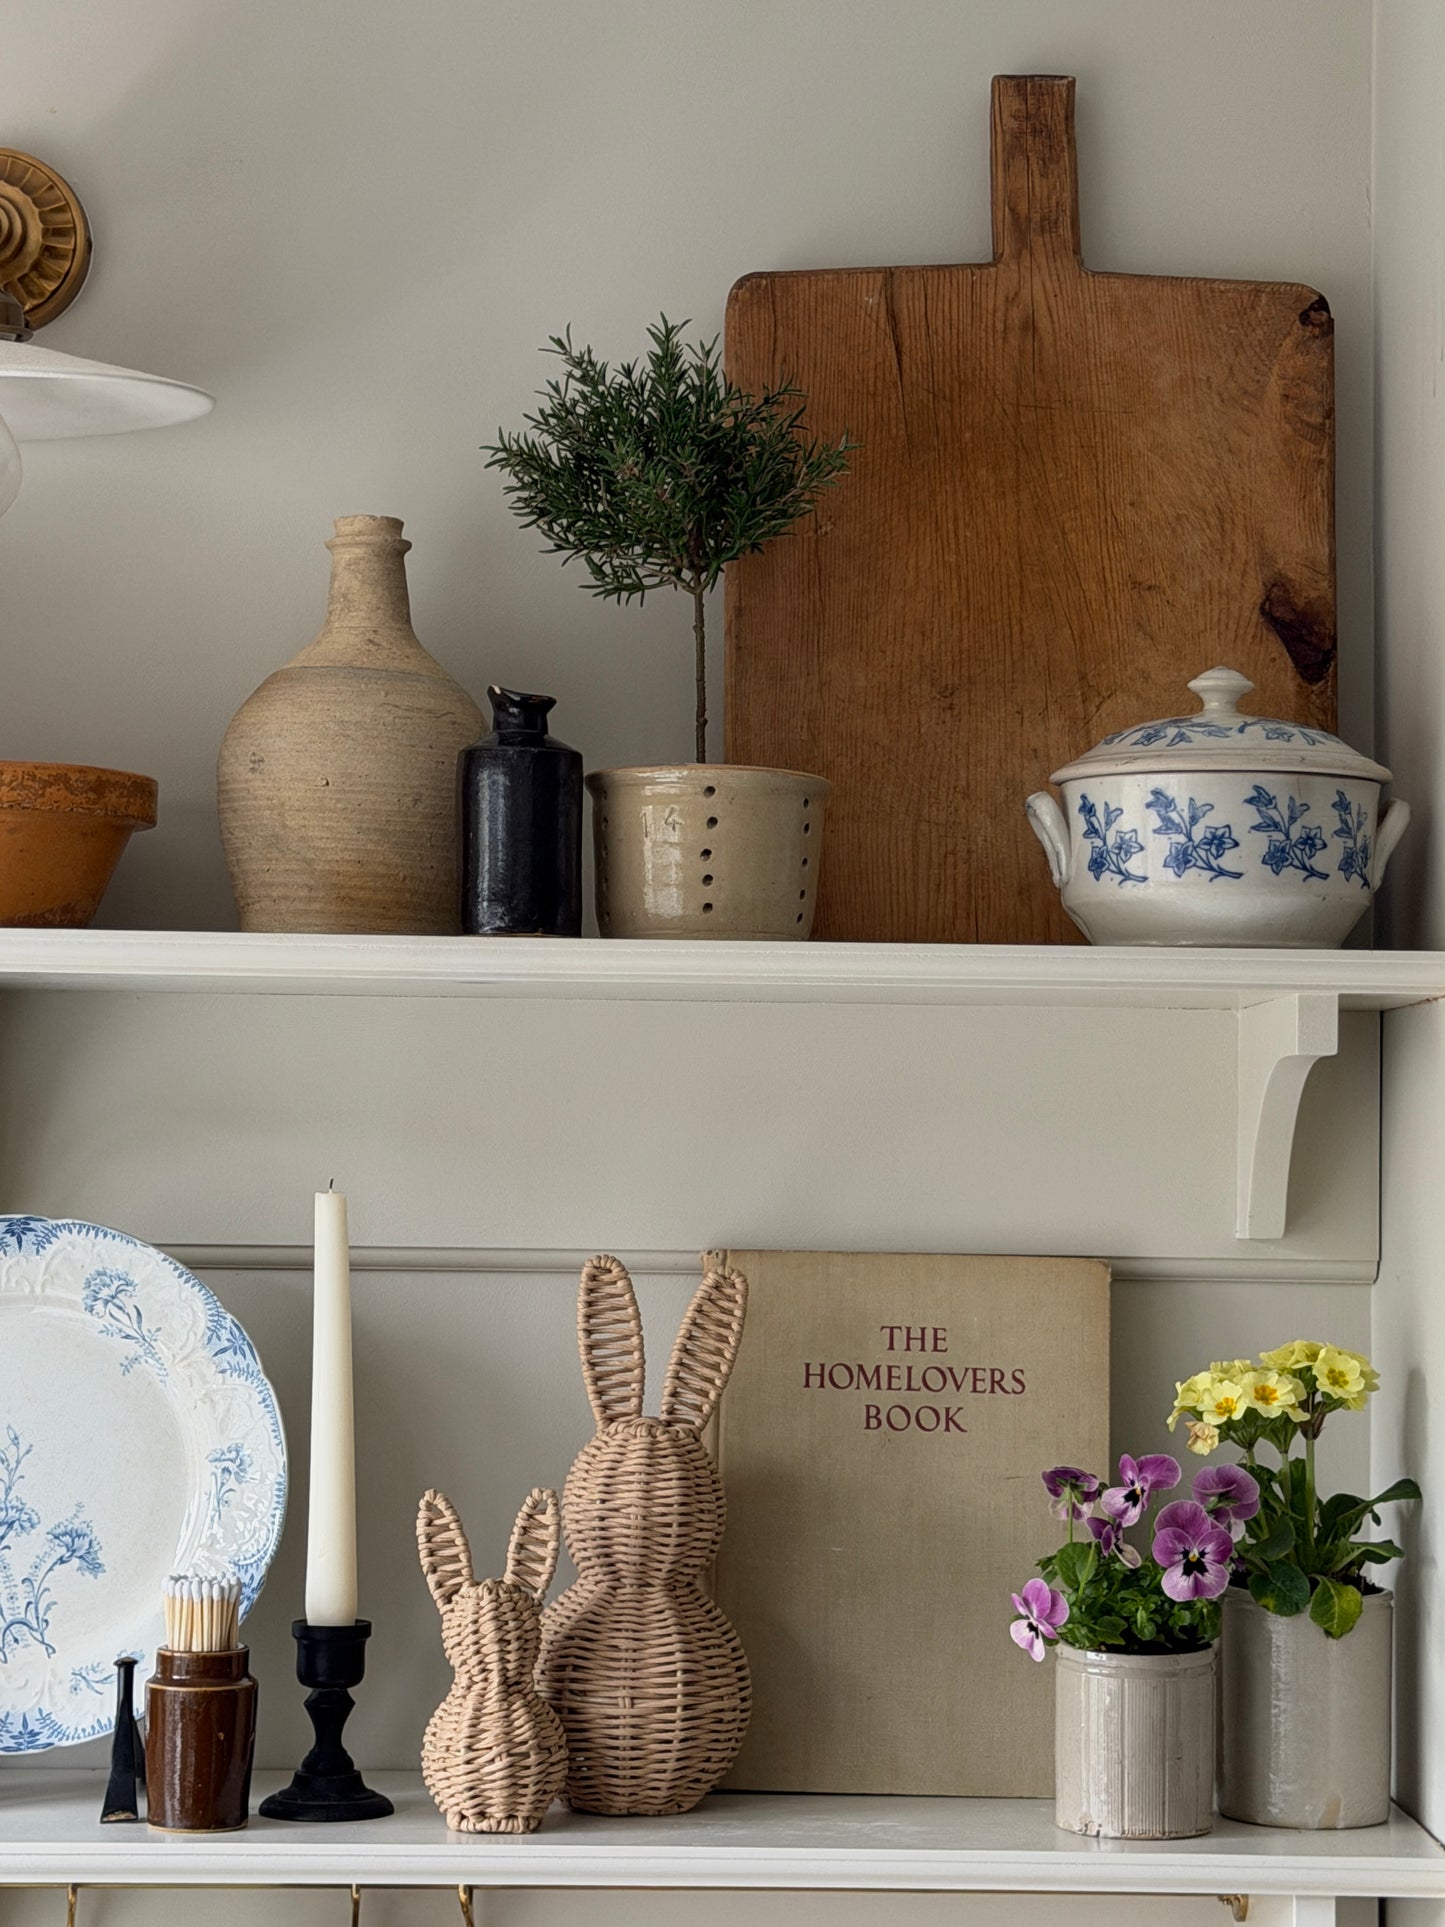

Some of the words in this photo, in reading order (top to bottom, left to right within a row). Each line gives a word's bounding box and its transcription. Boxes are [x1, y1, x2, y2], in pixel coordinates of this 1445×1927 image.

[880, 1326, 948, 1352] THE
[803, 1362, 1026, 1395] HOMELOVERS
[864, 1404, 967, 1433] BOOK
